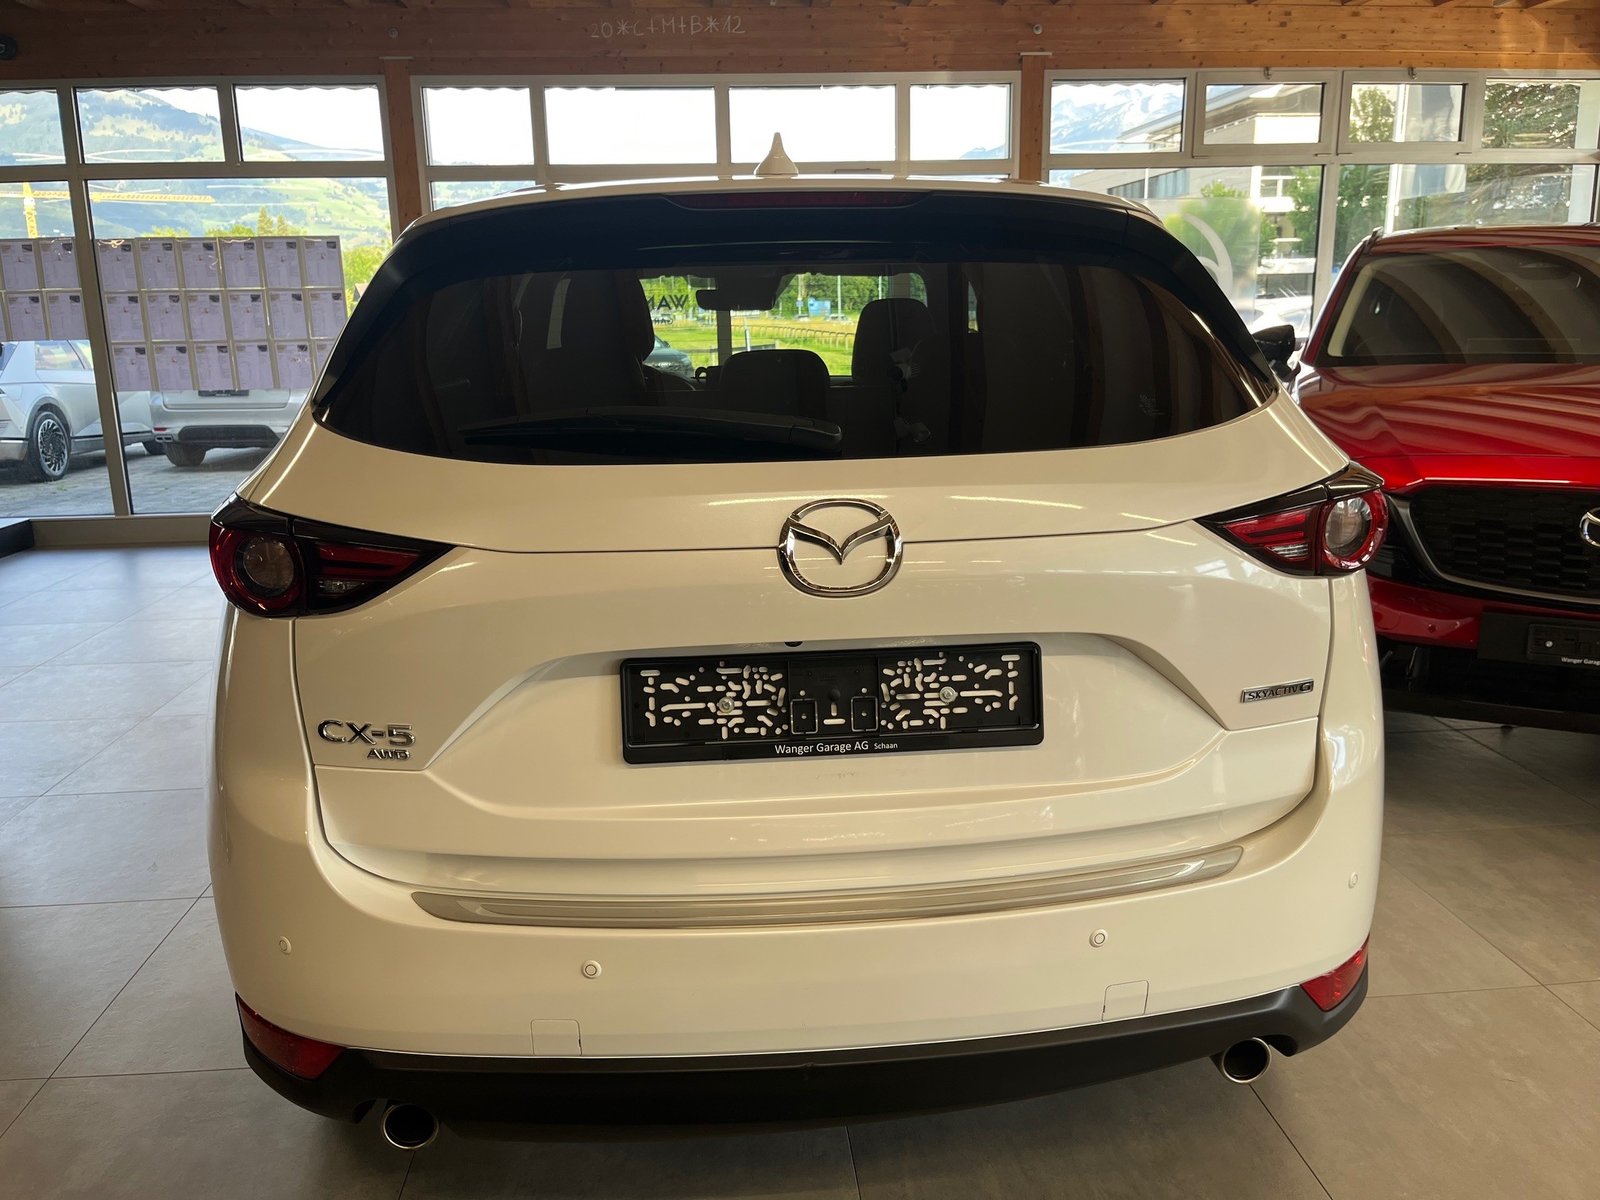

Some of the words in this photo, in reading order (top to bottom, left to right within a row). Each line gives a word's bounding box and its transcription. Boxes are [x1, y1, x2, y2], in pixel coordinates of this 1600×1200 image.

[318, 720, 416, 746] CX-5
[367, 748, 411, 760] AWD
[775, 744, 814, 755] Wanger
[816, 742, 851, 753] Garage
[854, 741, 869, 751] AG
[874, 742, 898, 750] Schaan
